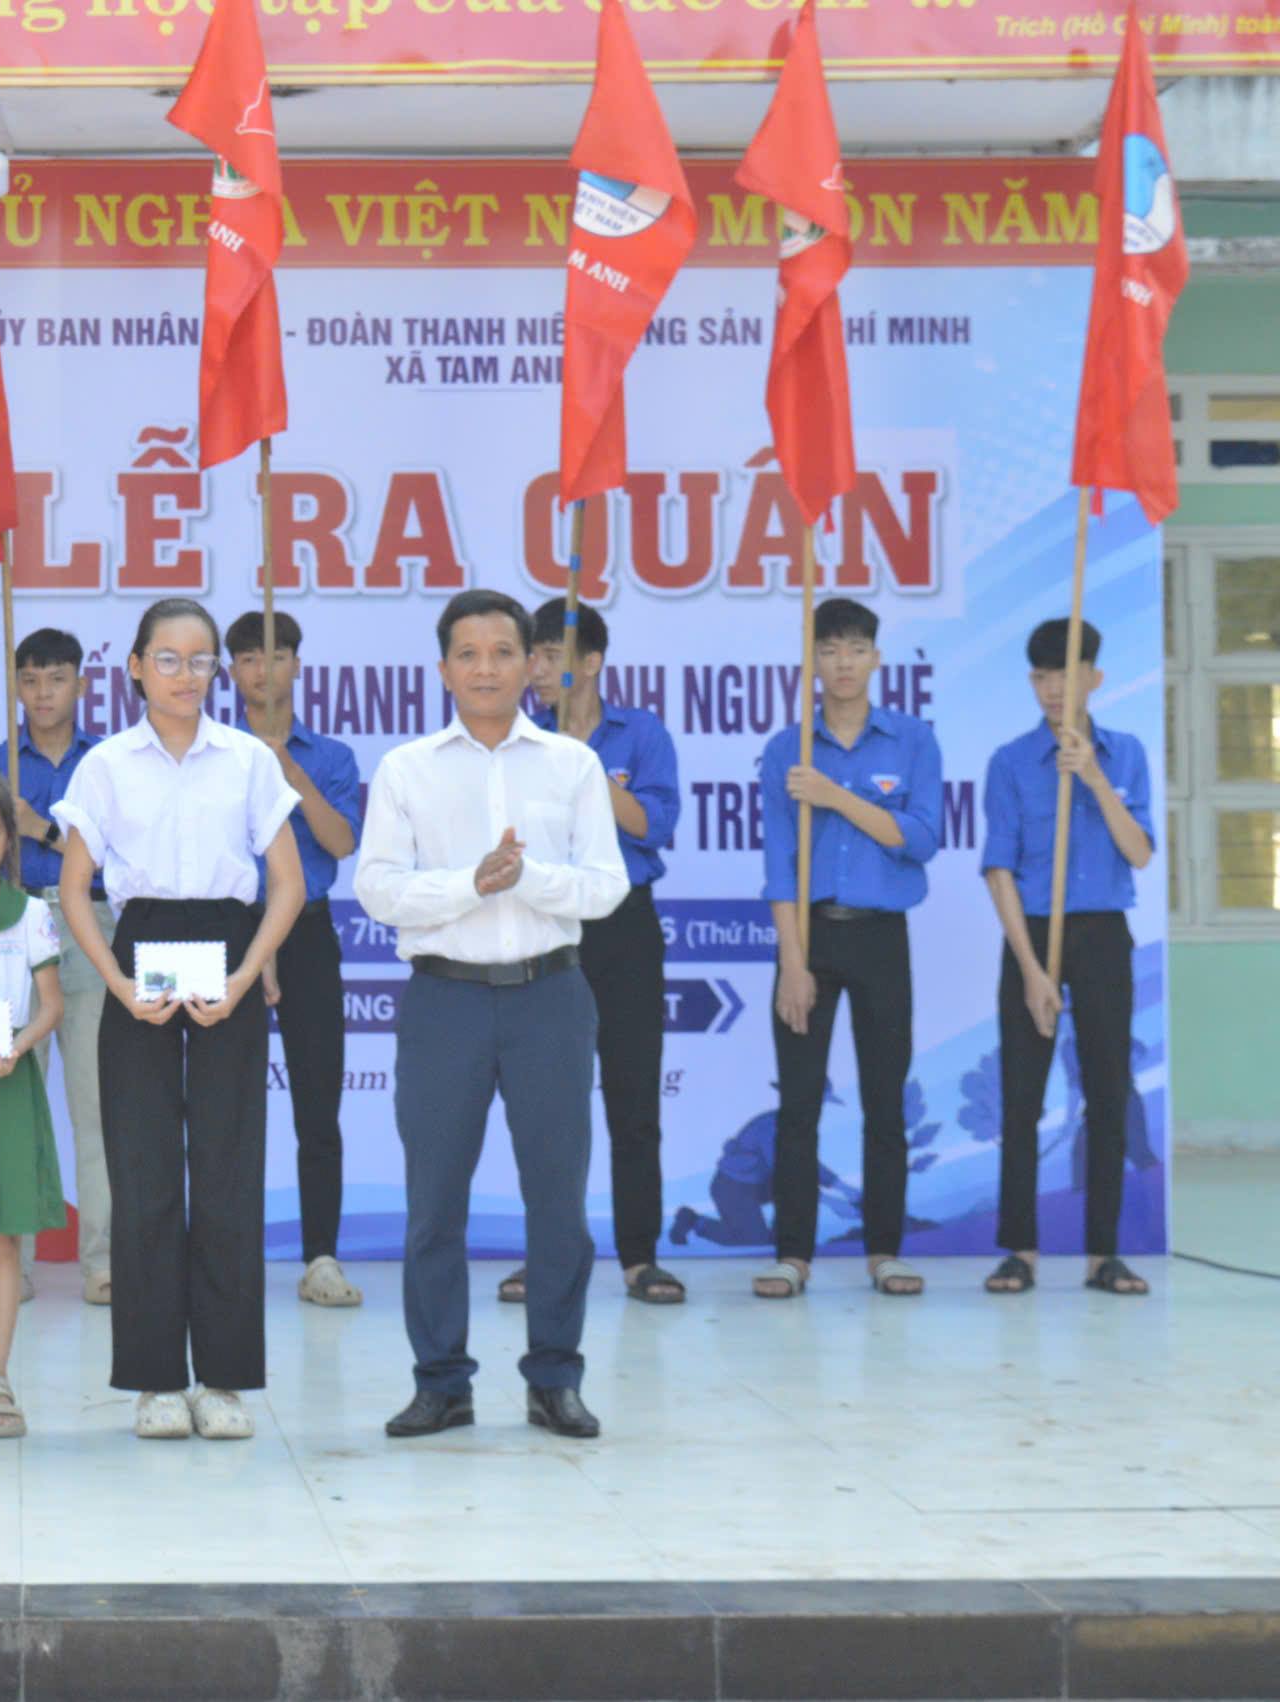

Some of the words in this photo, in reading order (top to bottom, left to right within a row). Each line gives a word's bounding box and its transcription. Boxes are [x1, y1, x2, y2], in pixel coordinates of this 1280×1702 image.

[325, 178, 500, 259] VIỆT
[941, 177, 1100, 245] NĂM
[586, 261, 630, 293] ANH
[37, 316, 101, 346] BAN
[112, 311, 200, 346] NHÂN
[307, 311, 392, 346] ĐOÀN
[403, 316, 505, 346] THANH
[516, 311, 565, 346] NIÊ
[698, 308, 762, 346] SẢN
[846, 310, 877, 346] HÍ
[888, 316, 972, 346] MINH
[385, 351, 426, 384] XÃ
[437, 355, 499, 384] TAM
[10, 427, 203, 590] LỄ
[255, 471, 467, 590] RA
[303, 665, 425, 735] HANH
